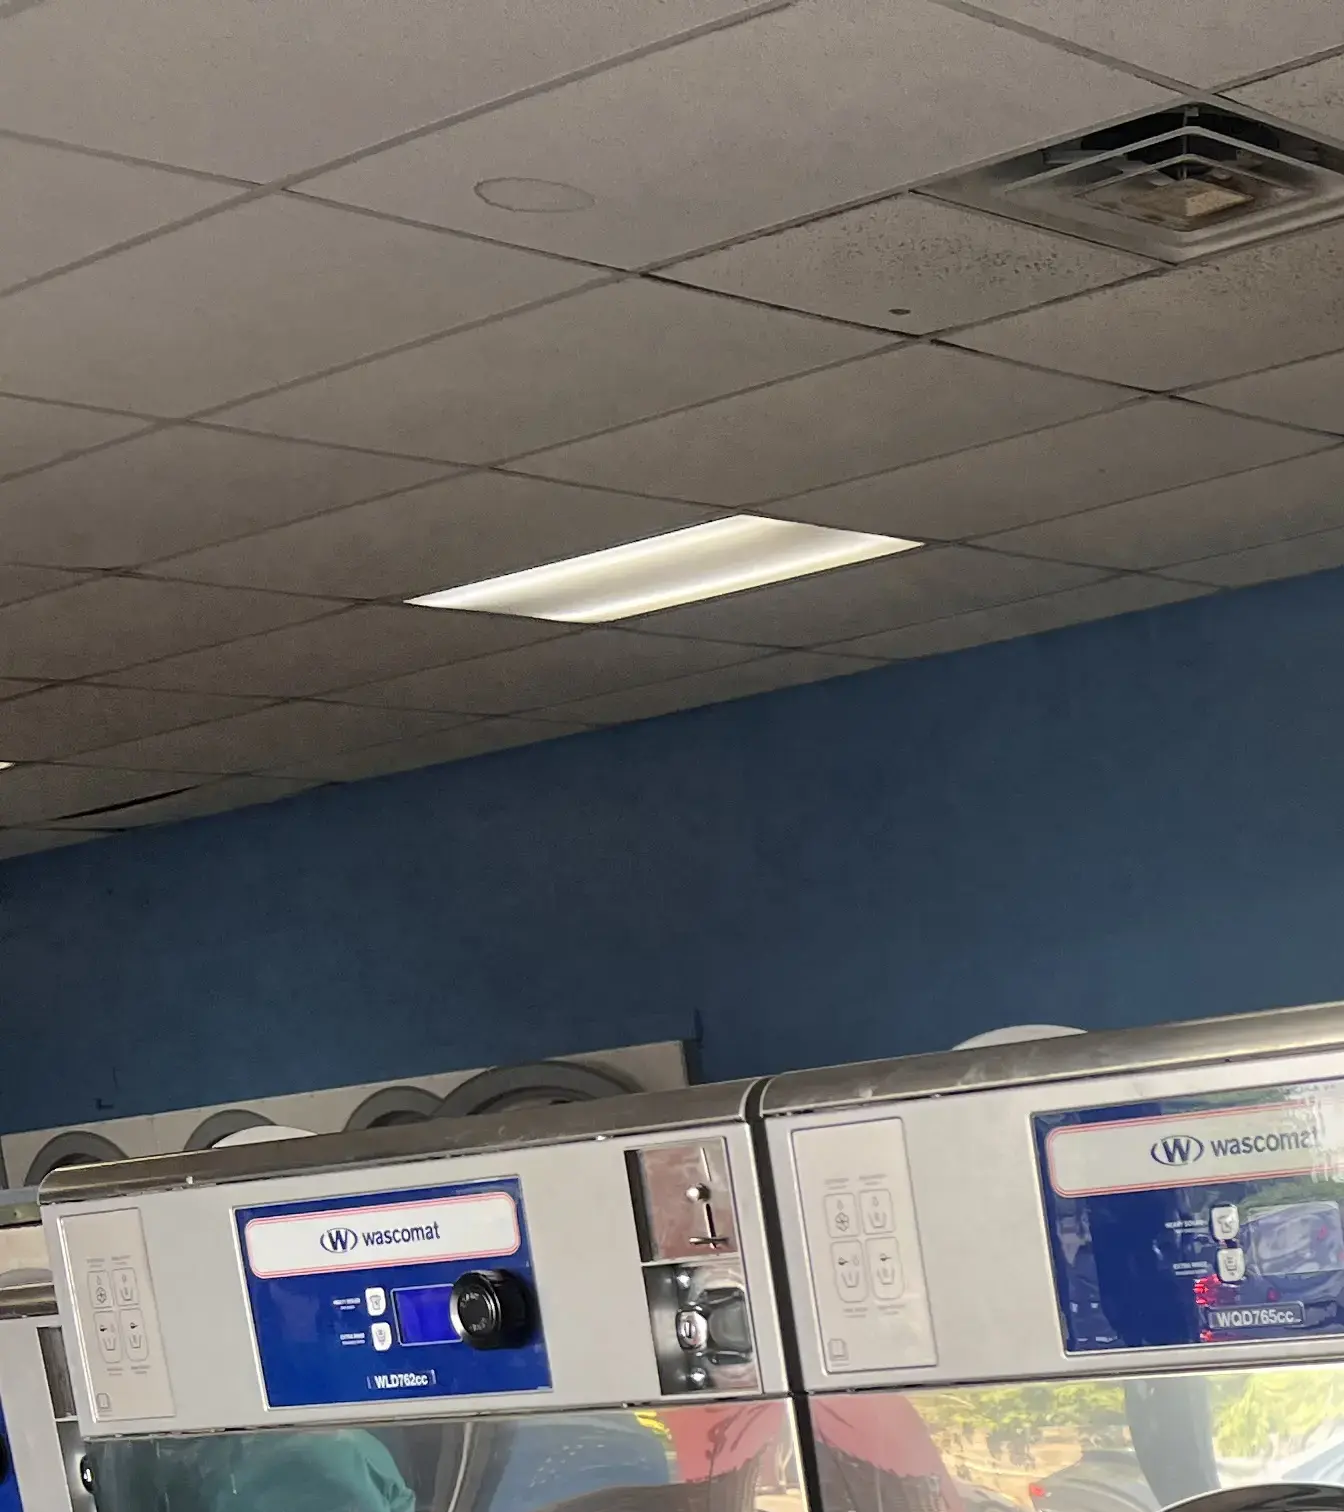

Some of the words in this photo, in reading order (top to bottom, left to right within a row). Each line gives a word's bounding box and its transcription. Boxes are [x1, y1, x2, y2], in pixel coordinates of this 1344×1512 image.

[1211, 1128, 1318, 1157] wascomat
[362, 1221, 441, 1247] wascomat
[1216, 1309, 1294, 1328] WQD765cc
[374, 1373, 429, 1389] WLD762cc
